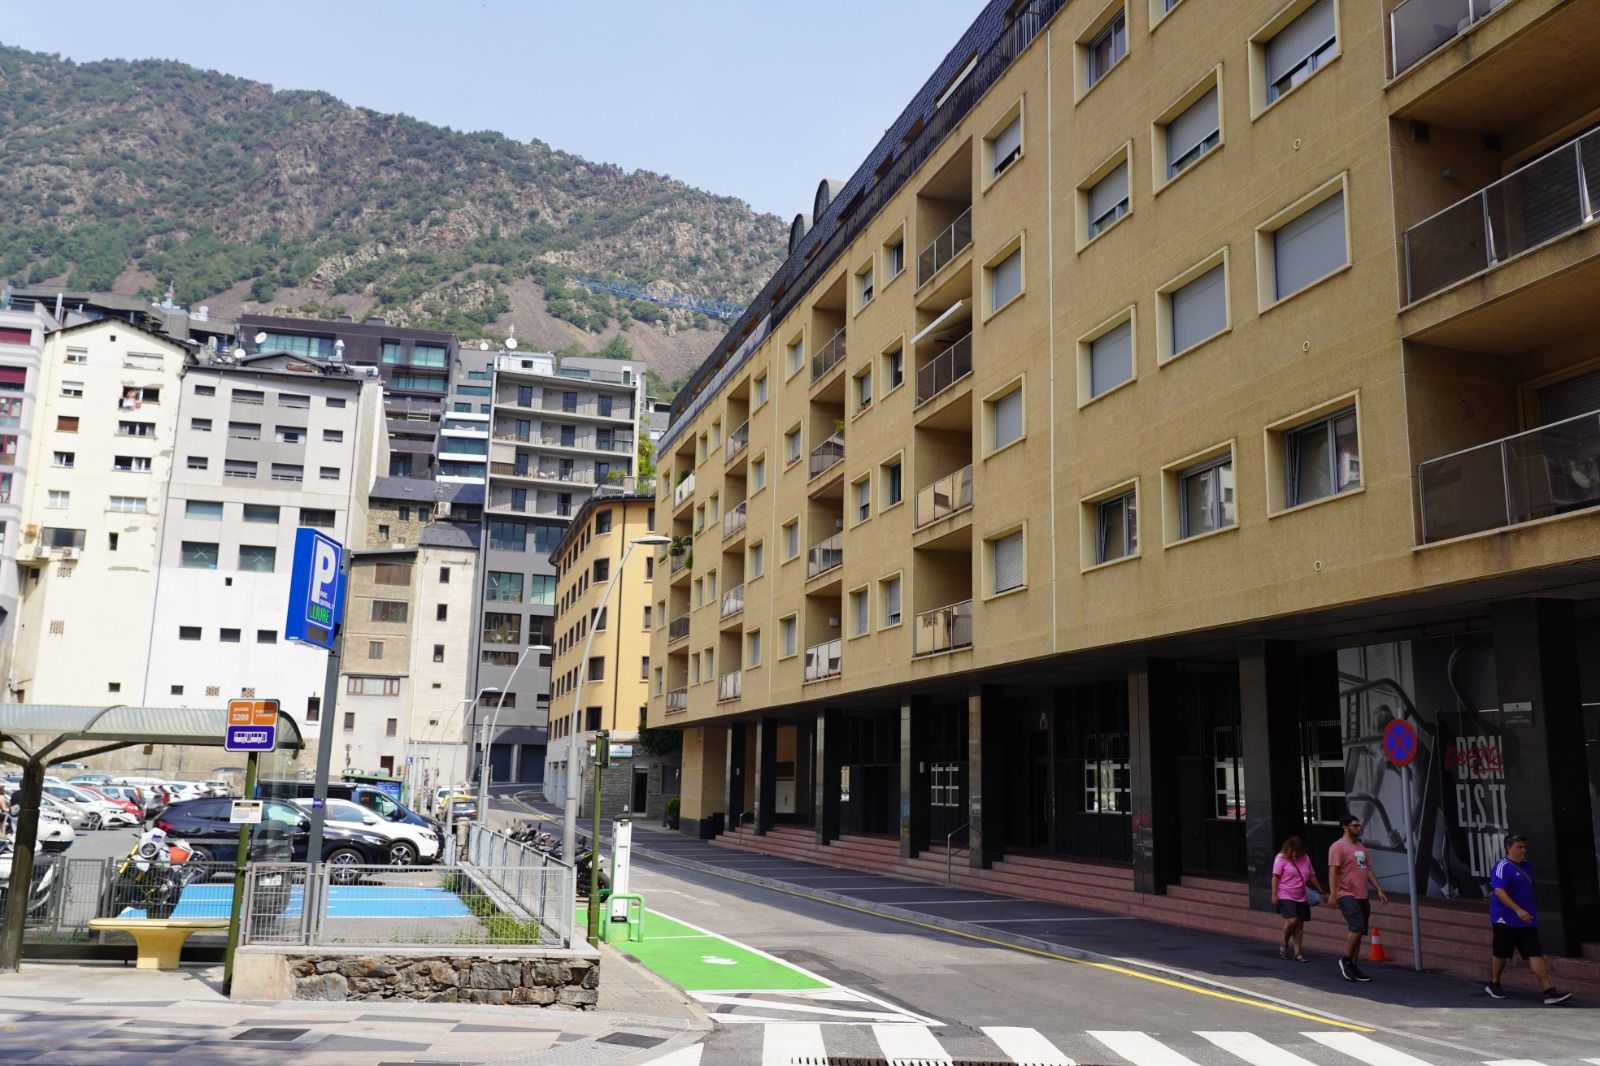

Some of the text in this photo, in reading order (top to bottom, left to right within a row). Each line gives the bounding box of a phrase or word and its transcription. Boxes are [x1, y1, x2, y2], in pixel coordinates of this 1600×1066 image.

[311, 539, 336, 603] P
[1456, 735, 1505, 780] DESA
[1456, 783, 1487, 829] ELS
